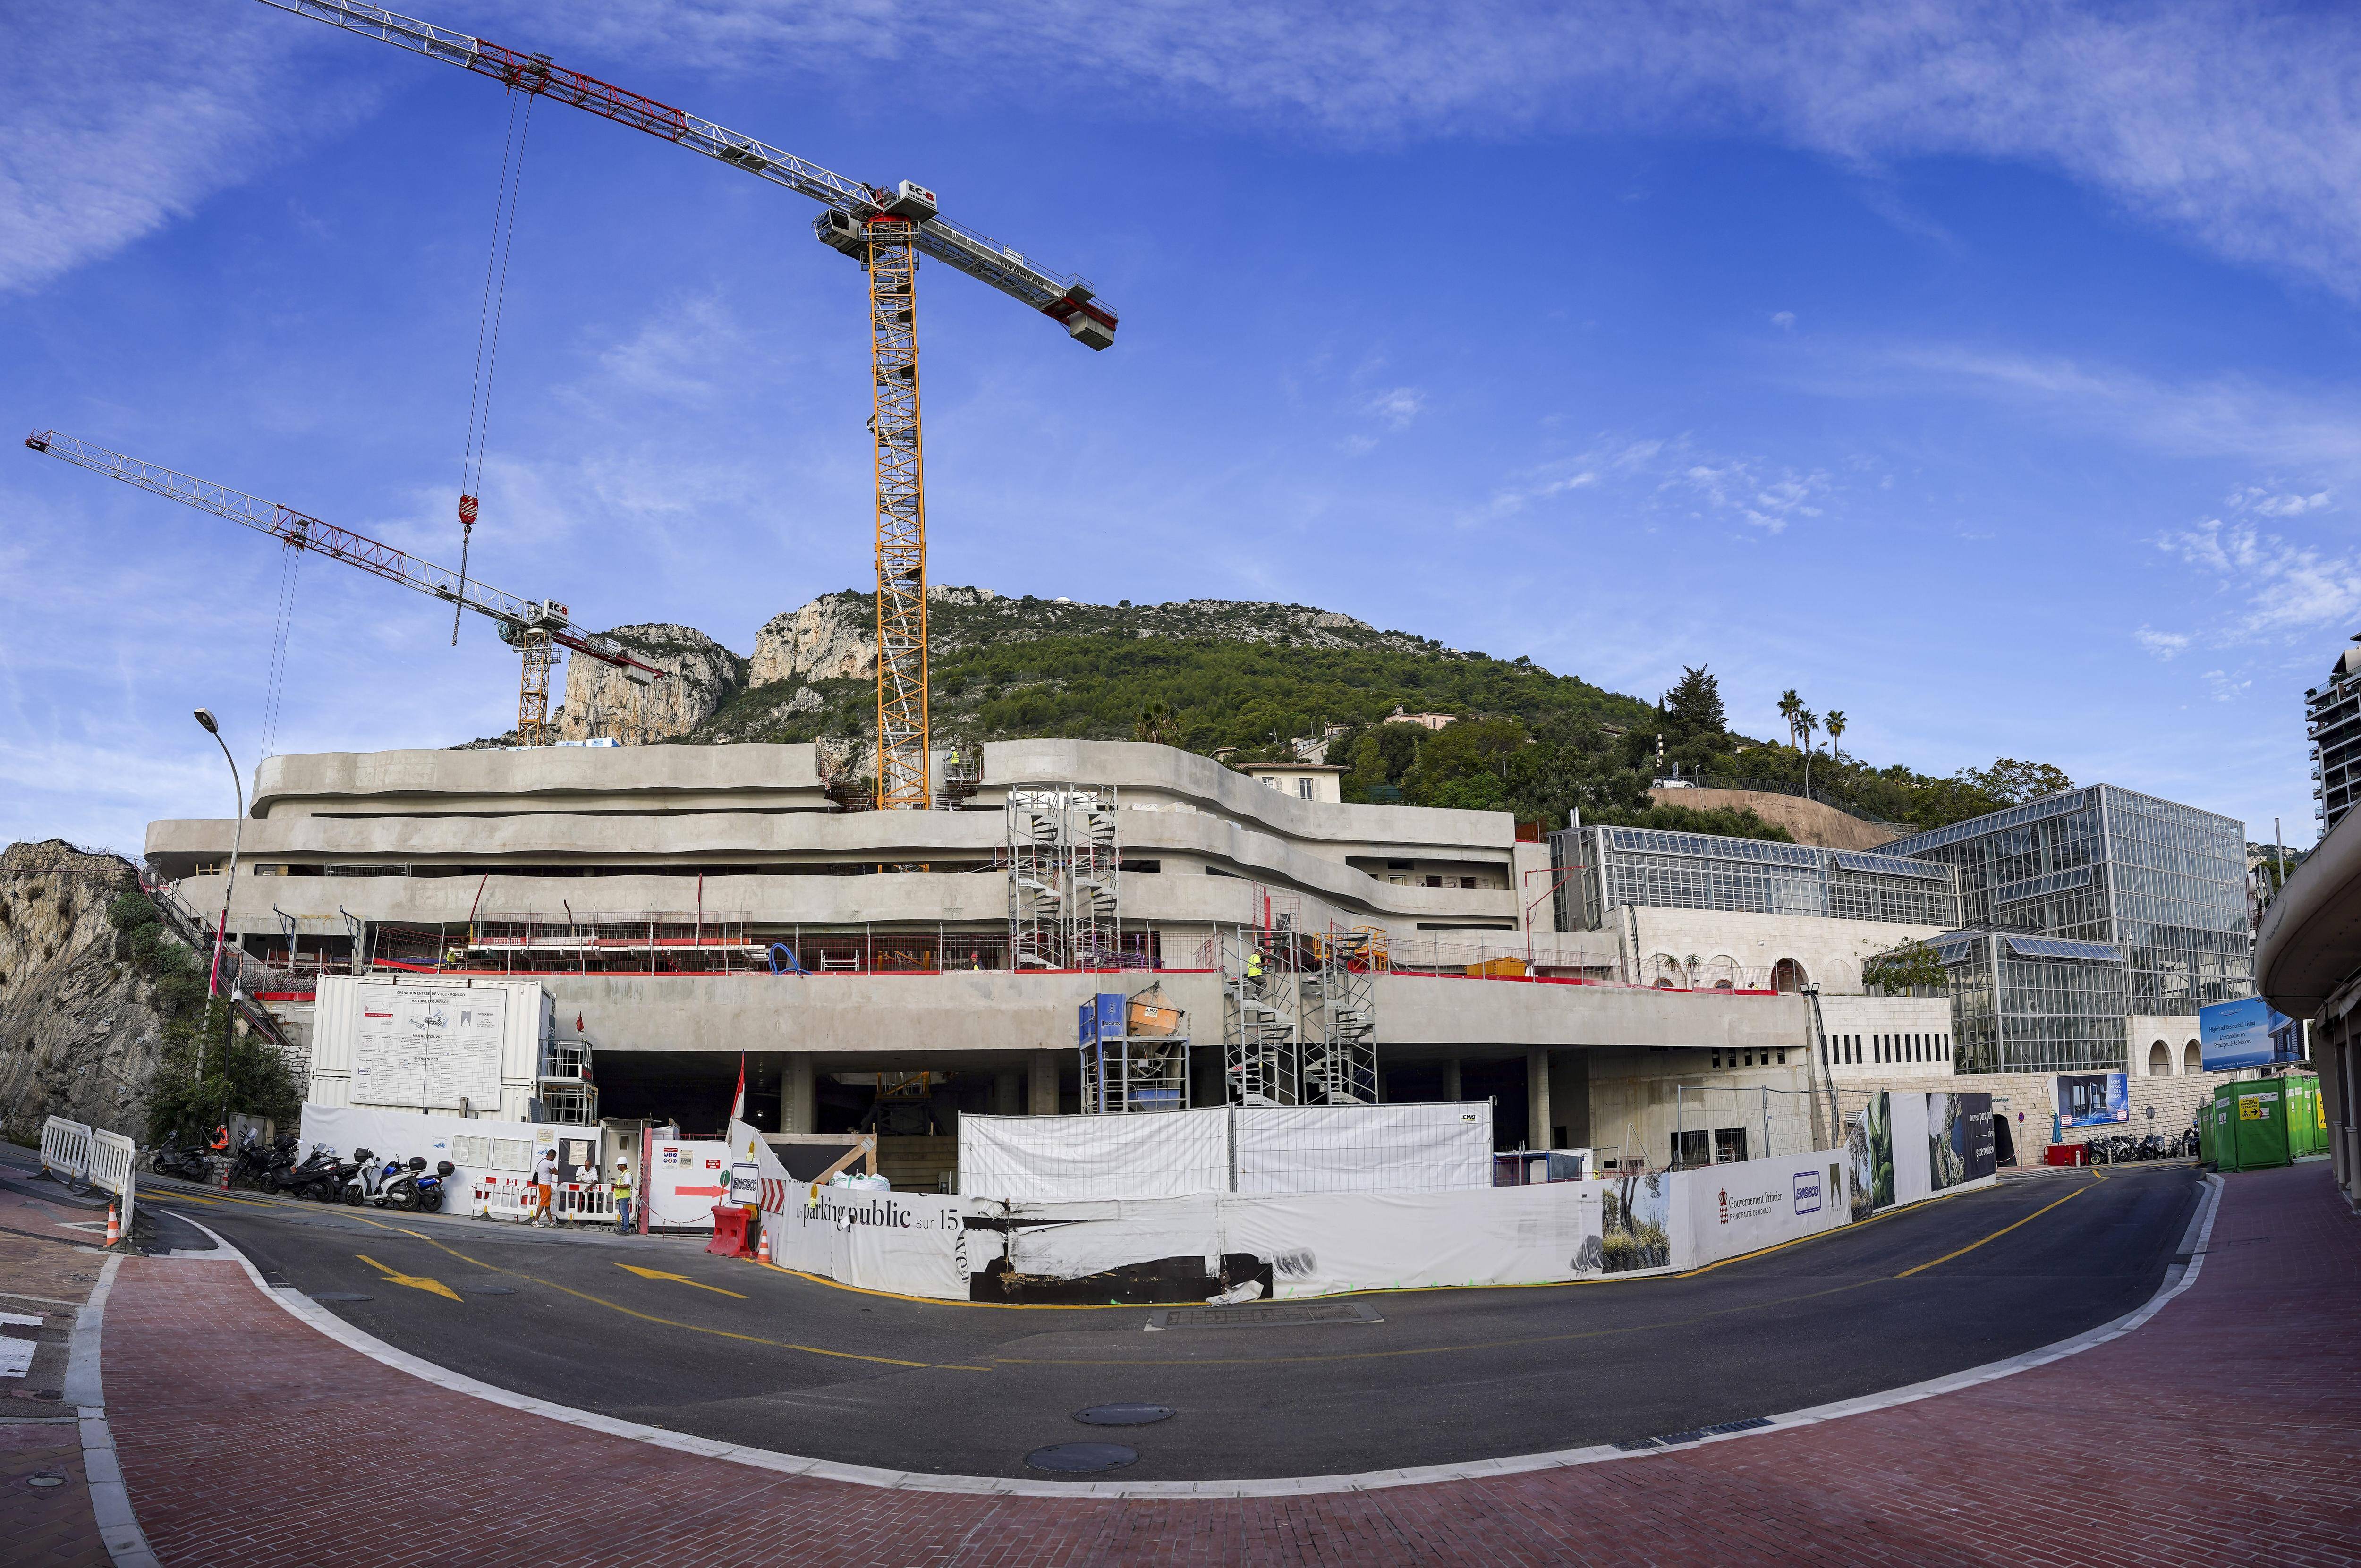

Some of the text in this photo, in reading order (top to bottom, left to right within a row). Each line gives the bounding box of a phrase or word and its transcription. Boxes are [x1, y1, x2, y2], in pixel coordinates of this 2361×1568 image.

[908, 183, 934, 201] EC-B
[908, 192, 935, 208] LIEBHERR
[549, 601, 568, 615] EC-B
[548, 612, 567, 622] LIEBHERR
[588, 644, 615, 657] LIEBHERR
[2209, 1025, 2225, 1033] High-End
[2225, 1022, 2244, 1030] Residential
[2219, 1032, 2240, 1040] L'immobilier
[733, 1178, 756, 1191] ENGECO
[1796, 1186, 1819, 1200] ENGECO
[1729, 1191, 1782, 1209] Gouvernement Princier
[797, 1208, 802, 1219] Un
[803, 1195, 845, 1231] parking
[849, 1199, 911, 1233] public
[916, 1219, 934, 1229] sur
[939, 1208, 958, 1230] 15
[1730, 1209, 1752, 1220] PRINCIPAUTÉ
[1758, 1207, 1771, 1215] MONACO
